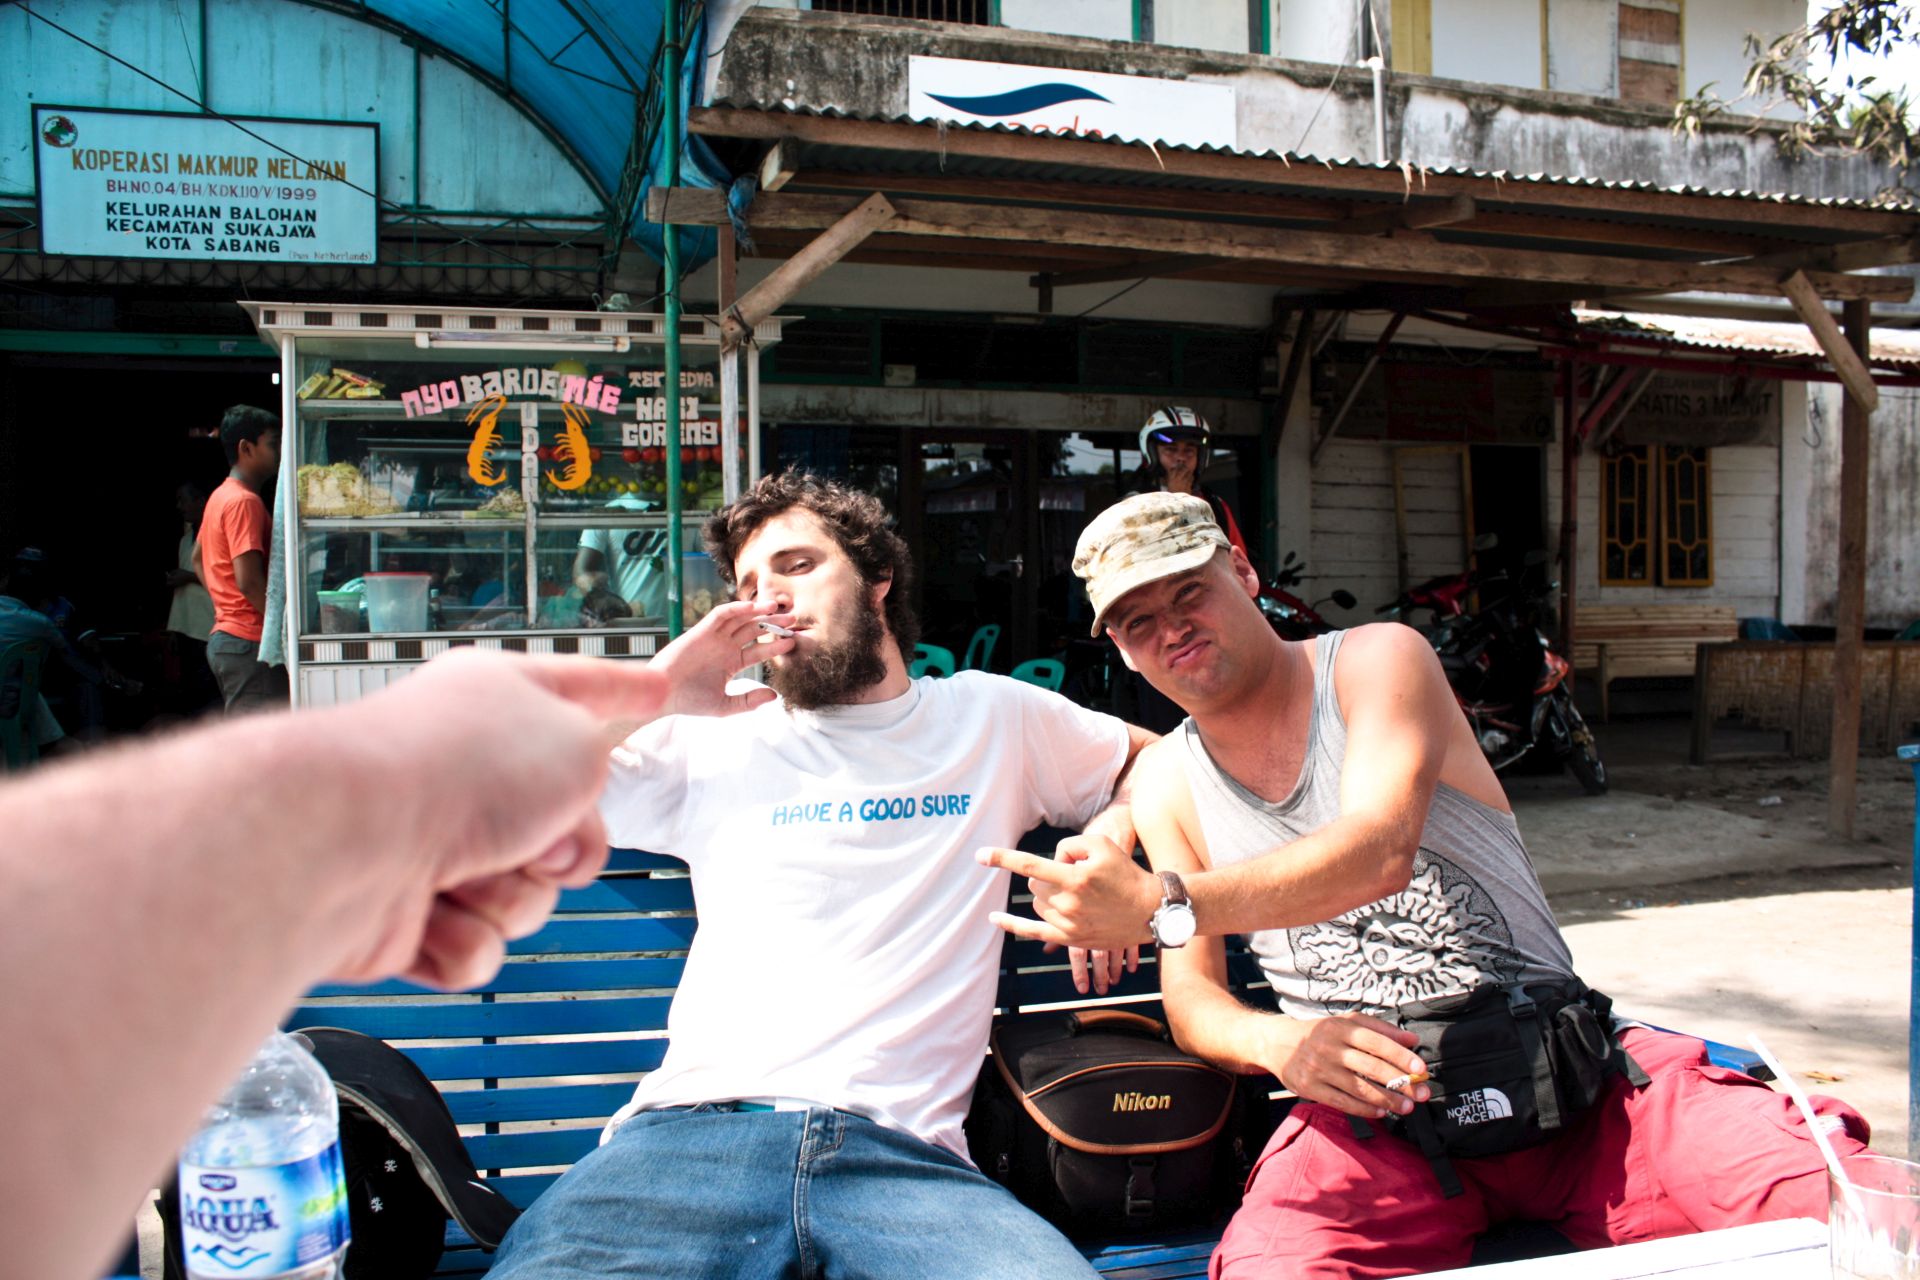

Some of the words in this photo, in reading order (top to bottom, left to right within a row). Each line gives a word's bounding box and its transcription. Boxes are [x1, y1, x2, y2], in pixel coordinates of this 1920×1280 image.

[72, 148, 169, 174] KOPERASI
[178, 154, 259, 179] MAKMUR
[267, 158, 347, 181] NELAYAN
[106, 202, 221, 220] KELURAHAN
[230, 206, 317, 223] BALOHAN
[106, 218, 213, 235] KECAMATAN
[224, 222, 316, 239] SUKAJAYA
[146, 237, 191, 251] KOTA
[204, 238, 280, 253] SABANG
[772, 803, 832, 826] HAVE
[838, 801, 854, 823] A
[859, 797, 916, 822] GOOD
[921, 794, 971, 817] SURF
[1112, 1092, 1171, 1112] Nikon
[1458, 1090, 1483, 1103] THE
[1446, 1101, 1486, 1120] NORTH
[1457, 1110, 1490, 1127] FACE
